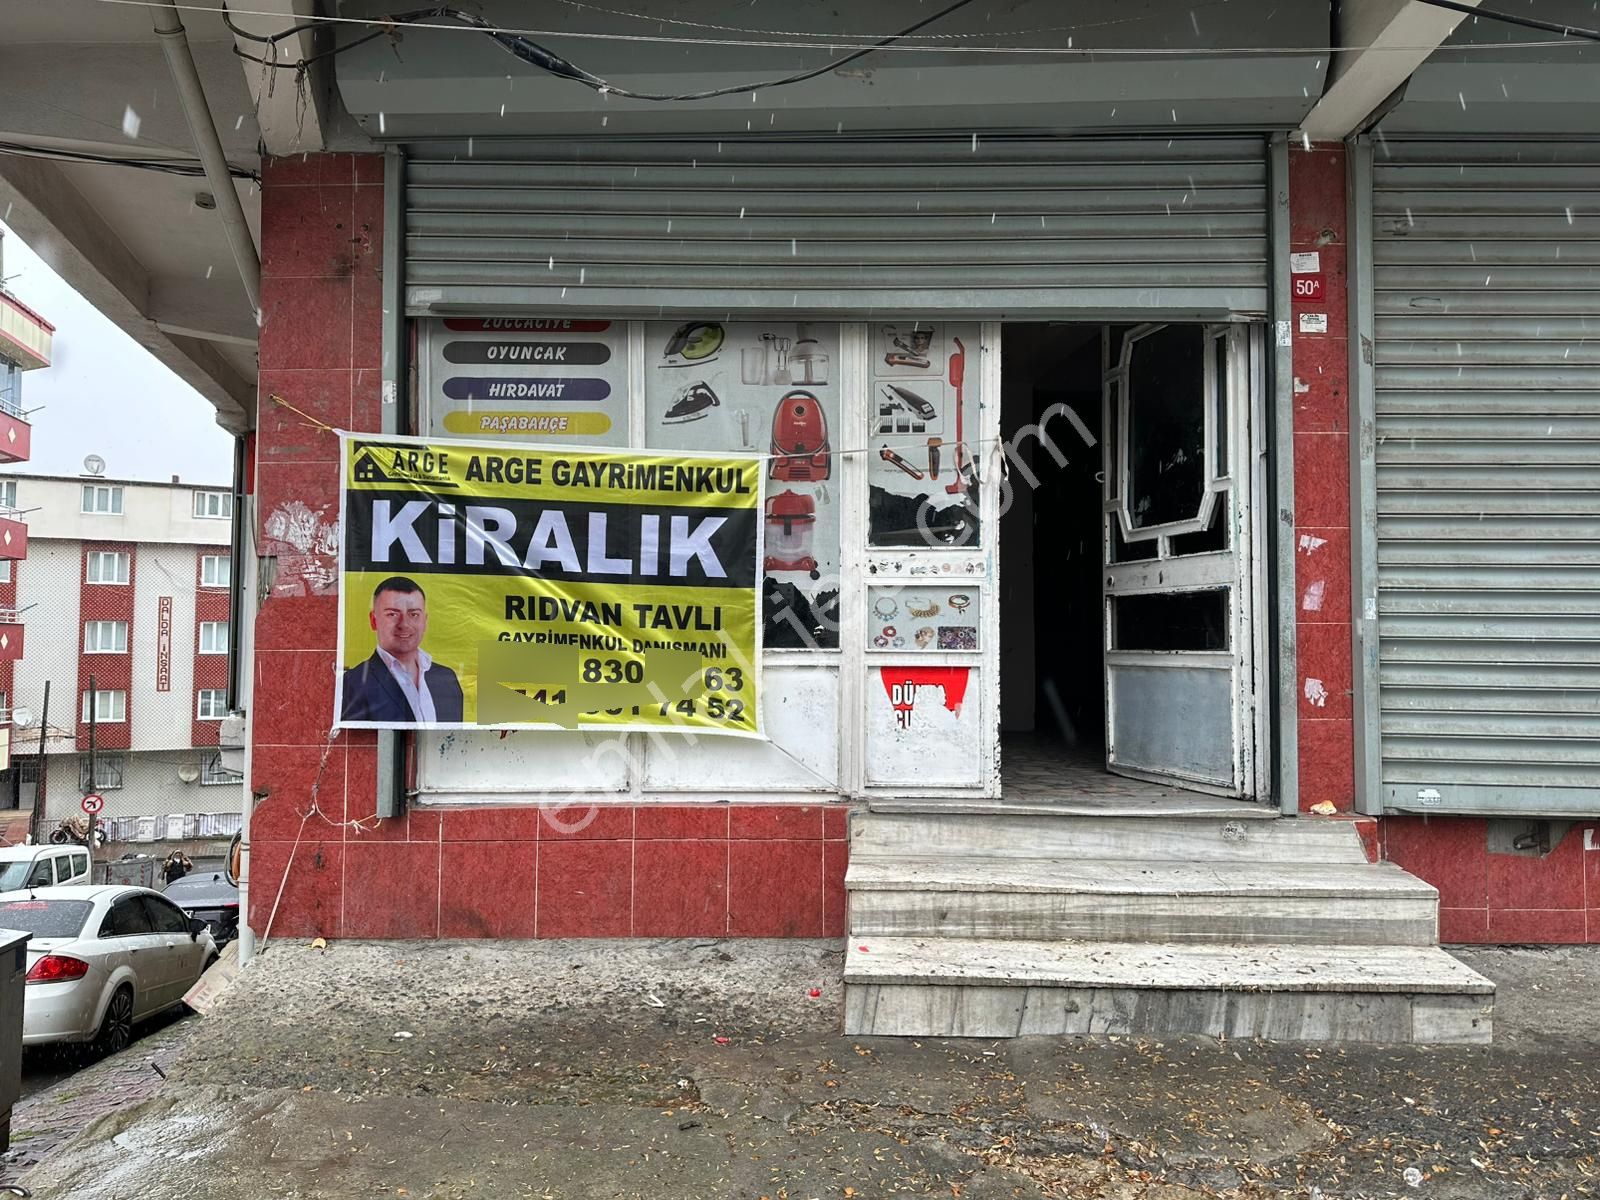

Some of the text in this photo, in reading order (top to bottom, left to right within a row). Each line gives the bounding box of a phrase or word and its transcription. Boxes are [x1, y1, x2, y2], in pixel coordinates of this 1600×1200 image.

[487, 346, 567, 361] OYUNCAK
[489, 384, 565, 398] HIRDAVAT
[480, 416, 568, 435] PAŞABAHÇE
[392, 450, 449, 475] ARGE
[465, 454, 543, 487] ARGE
[505, 595, 721, 631] RIDVAN TAVLI
[582, 658, 744, 692] 830 63
[707, 697, 745, 722] 52
